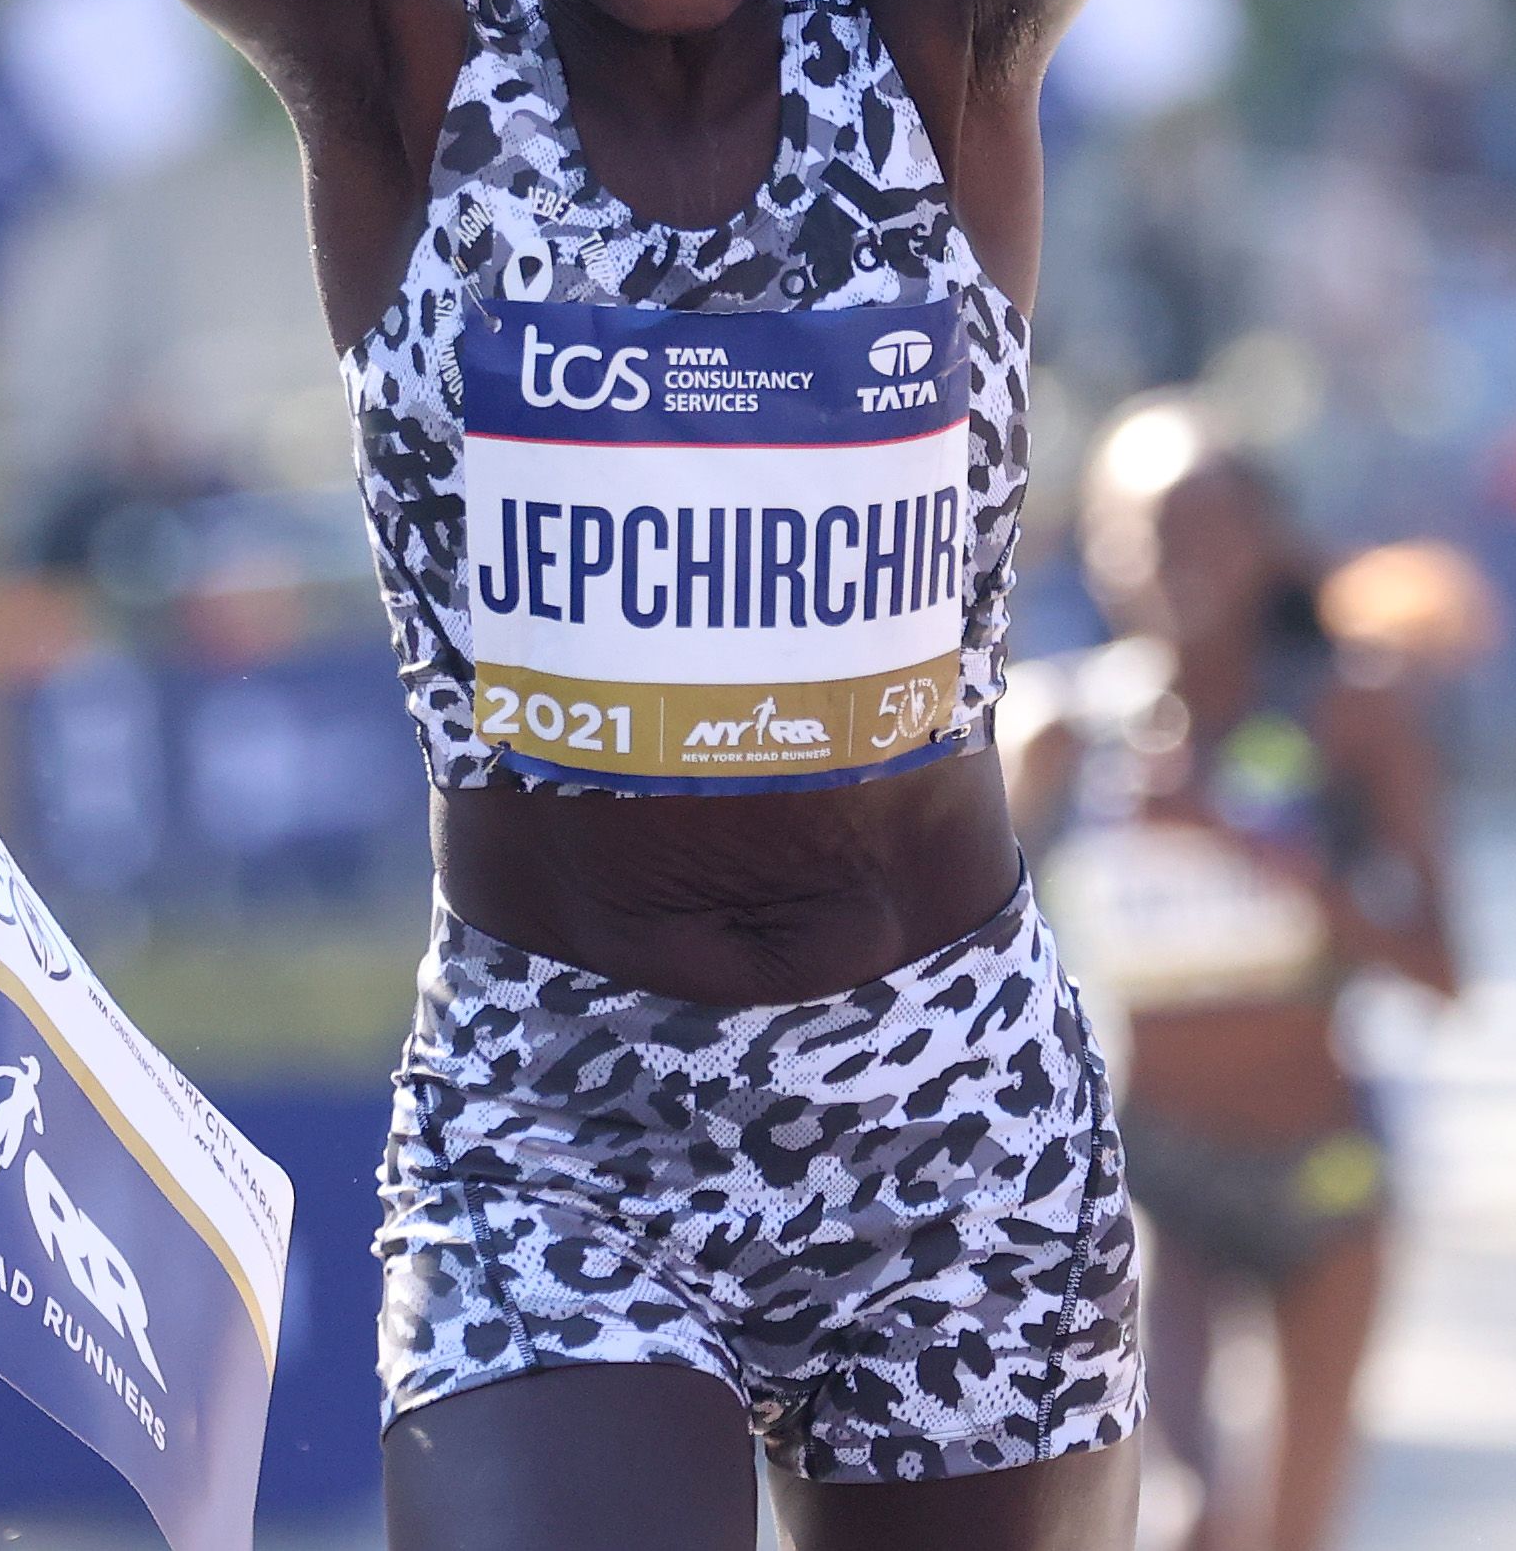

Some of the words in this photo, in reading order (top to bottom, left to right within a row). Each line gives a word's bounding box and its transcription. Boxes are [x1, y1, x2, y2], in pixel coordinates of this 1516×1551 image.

[521, 324, 651, 412] tcs
[664, 370, 814, 390] CONSULTANCY
[665, 348, 728, 366] TATA
[664, 393, 759, 412] SERVICES
[857, 380, 938, 413] TATA
[478, 485, 959, 629] JEPCHIRCHIR
[482, 686, 632, 754] 2021
[683, 753, 710, 763] NEW
[712, 752, 744, 763] YORK
[746, 752, 779, 762] ROAD
[781, 747, 832, 761] RUNNERS
[86, 985, 109, 1019] TATA
[109, 1014, 157, 1081] CONSULTANCY
[205, 1110, 238, 1162] CITY
[42, 1296, 167, 1452] RUNNERS
